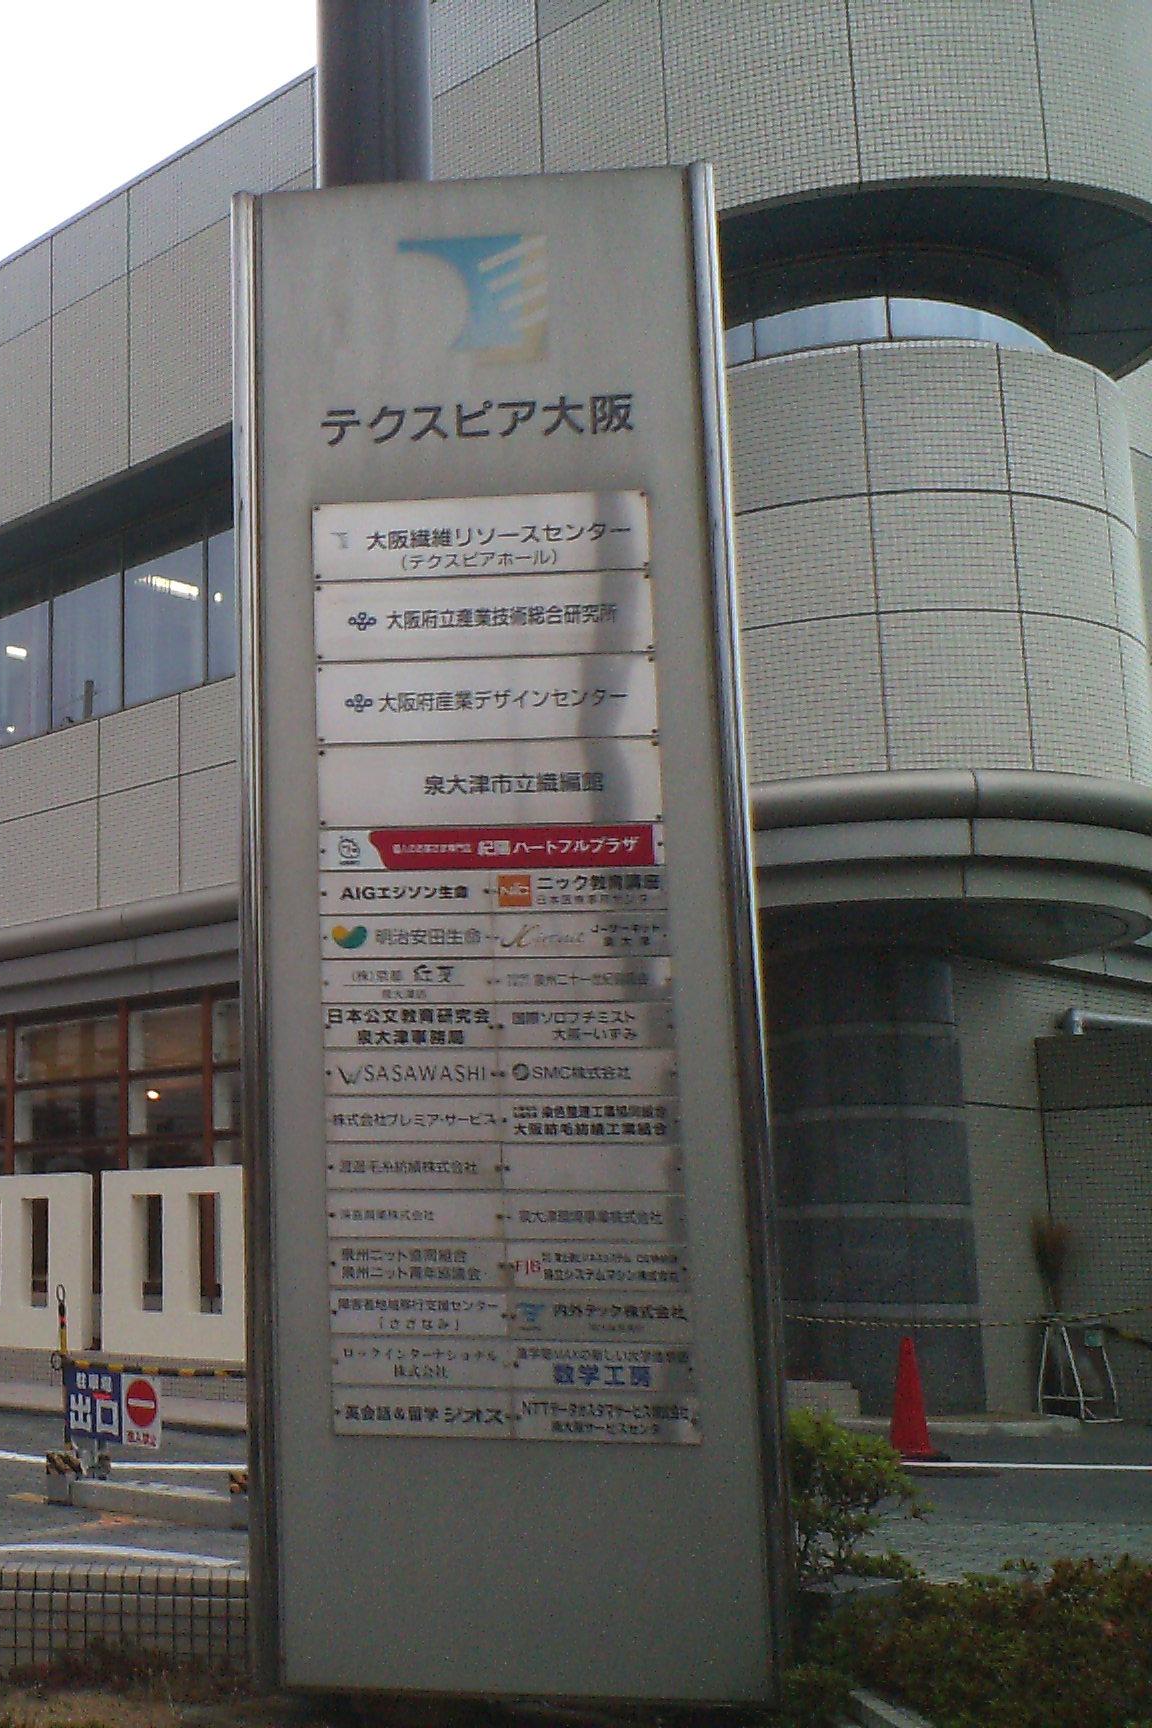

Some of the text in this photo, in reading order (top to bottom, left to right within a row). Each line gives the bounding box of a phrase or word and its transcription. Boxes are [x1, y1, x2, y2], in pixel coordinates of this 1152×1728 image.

[320, 394, 634, 447] テクスピア大阪
[366, 523, 631, 551] 大阪繊維リソースセンター
[378, 688, 629, 713] 大阪府産業デザインセンター
[340, 885, 470, 901] AIGエジソン生命
[375, 927, 482, 946] 明治安田生命
[363, 1064, 487, 1083] SASAWASHI
[70, 1392, 120, 1437] 出口
